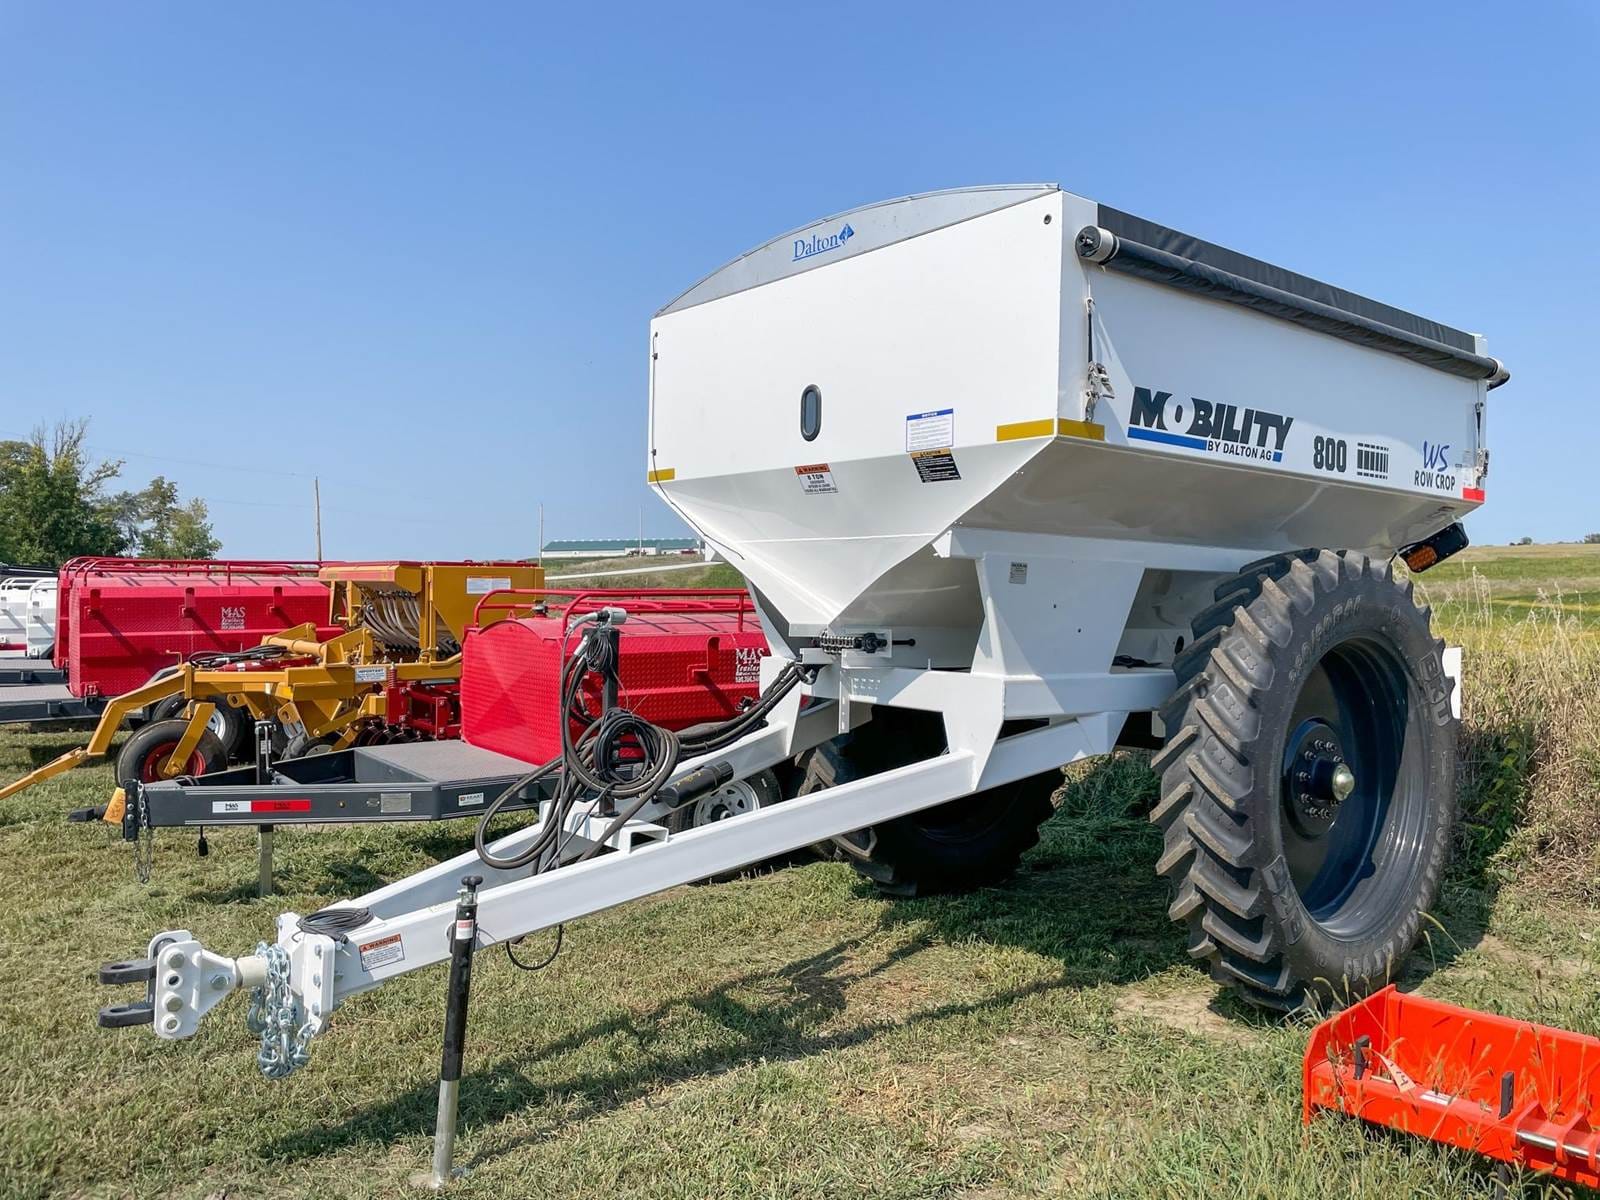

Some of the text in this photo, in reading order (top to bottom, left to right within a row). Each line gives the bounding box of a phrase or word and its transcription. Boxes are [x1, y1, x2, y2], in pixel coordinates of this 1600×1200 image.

[794, 234, 838, 258] Dalton
[1129, 386, 1294, 450] MOBILITY
[1207, 441, 1272, 461] BY DALTON AG
[1313, 435, 1347, 473] 800
[1422, 440, 1450, 473] WS
[1414, 470, 1456, 492] ROW CROP
[1420, 652, 1453, 727] BKT
[369, 936, 399, 948] WARNING
